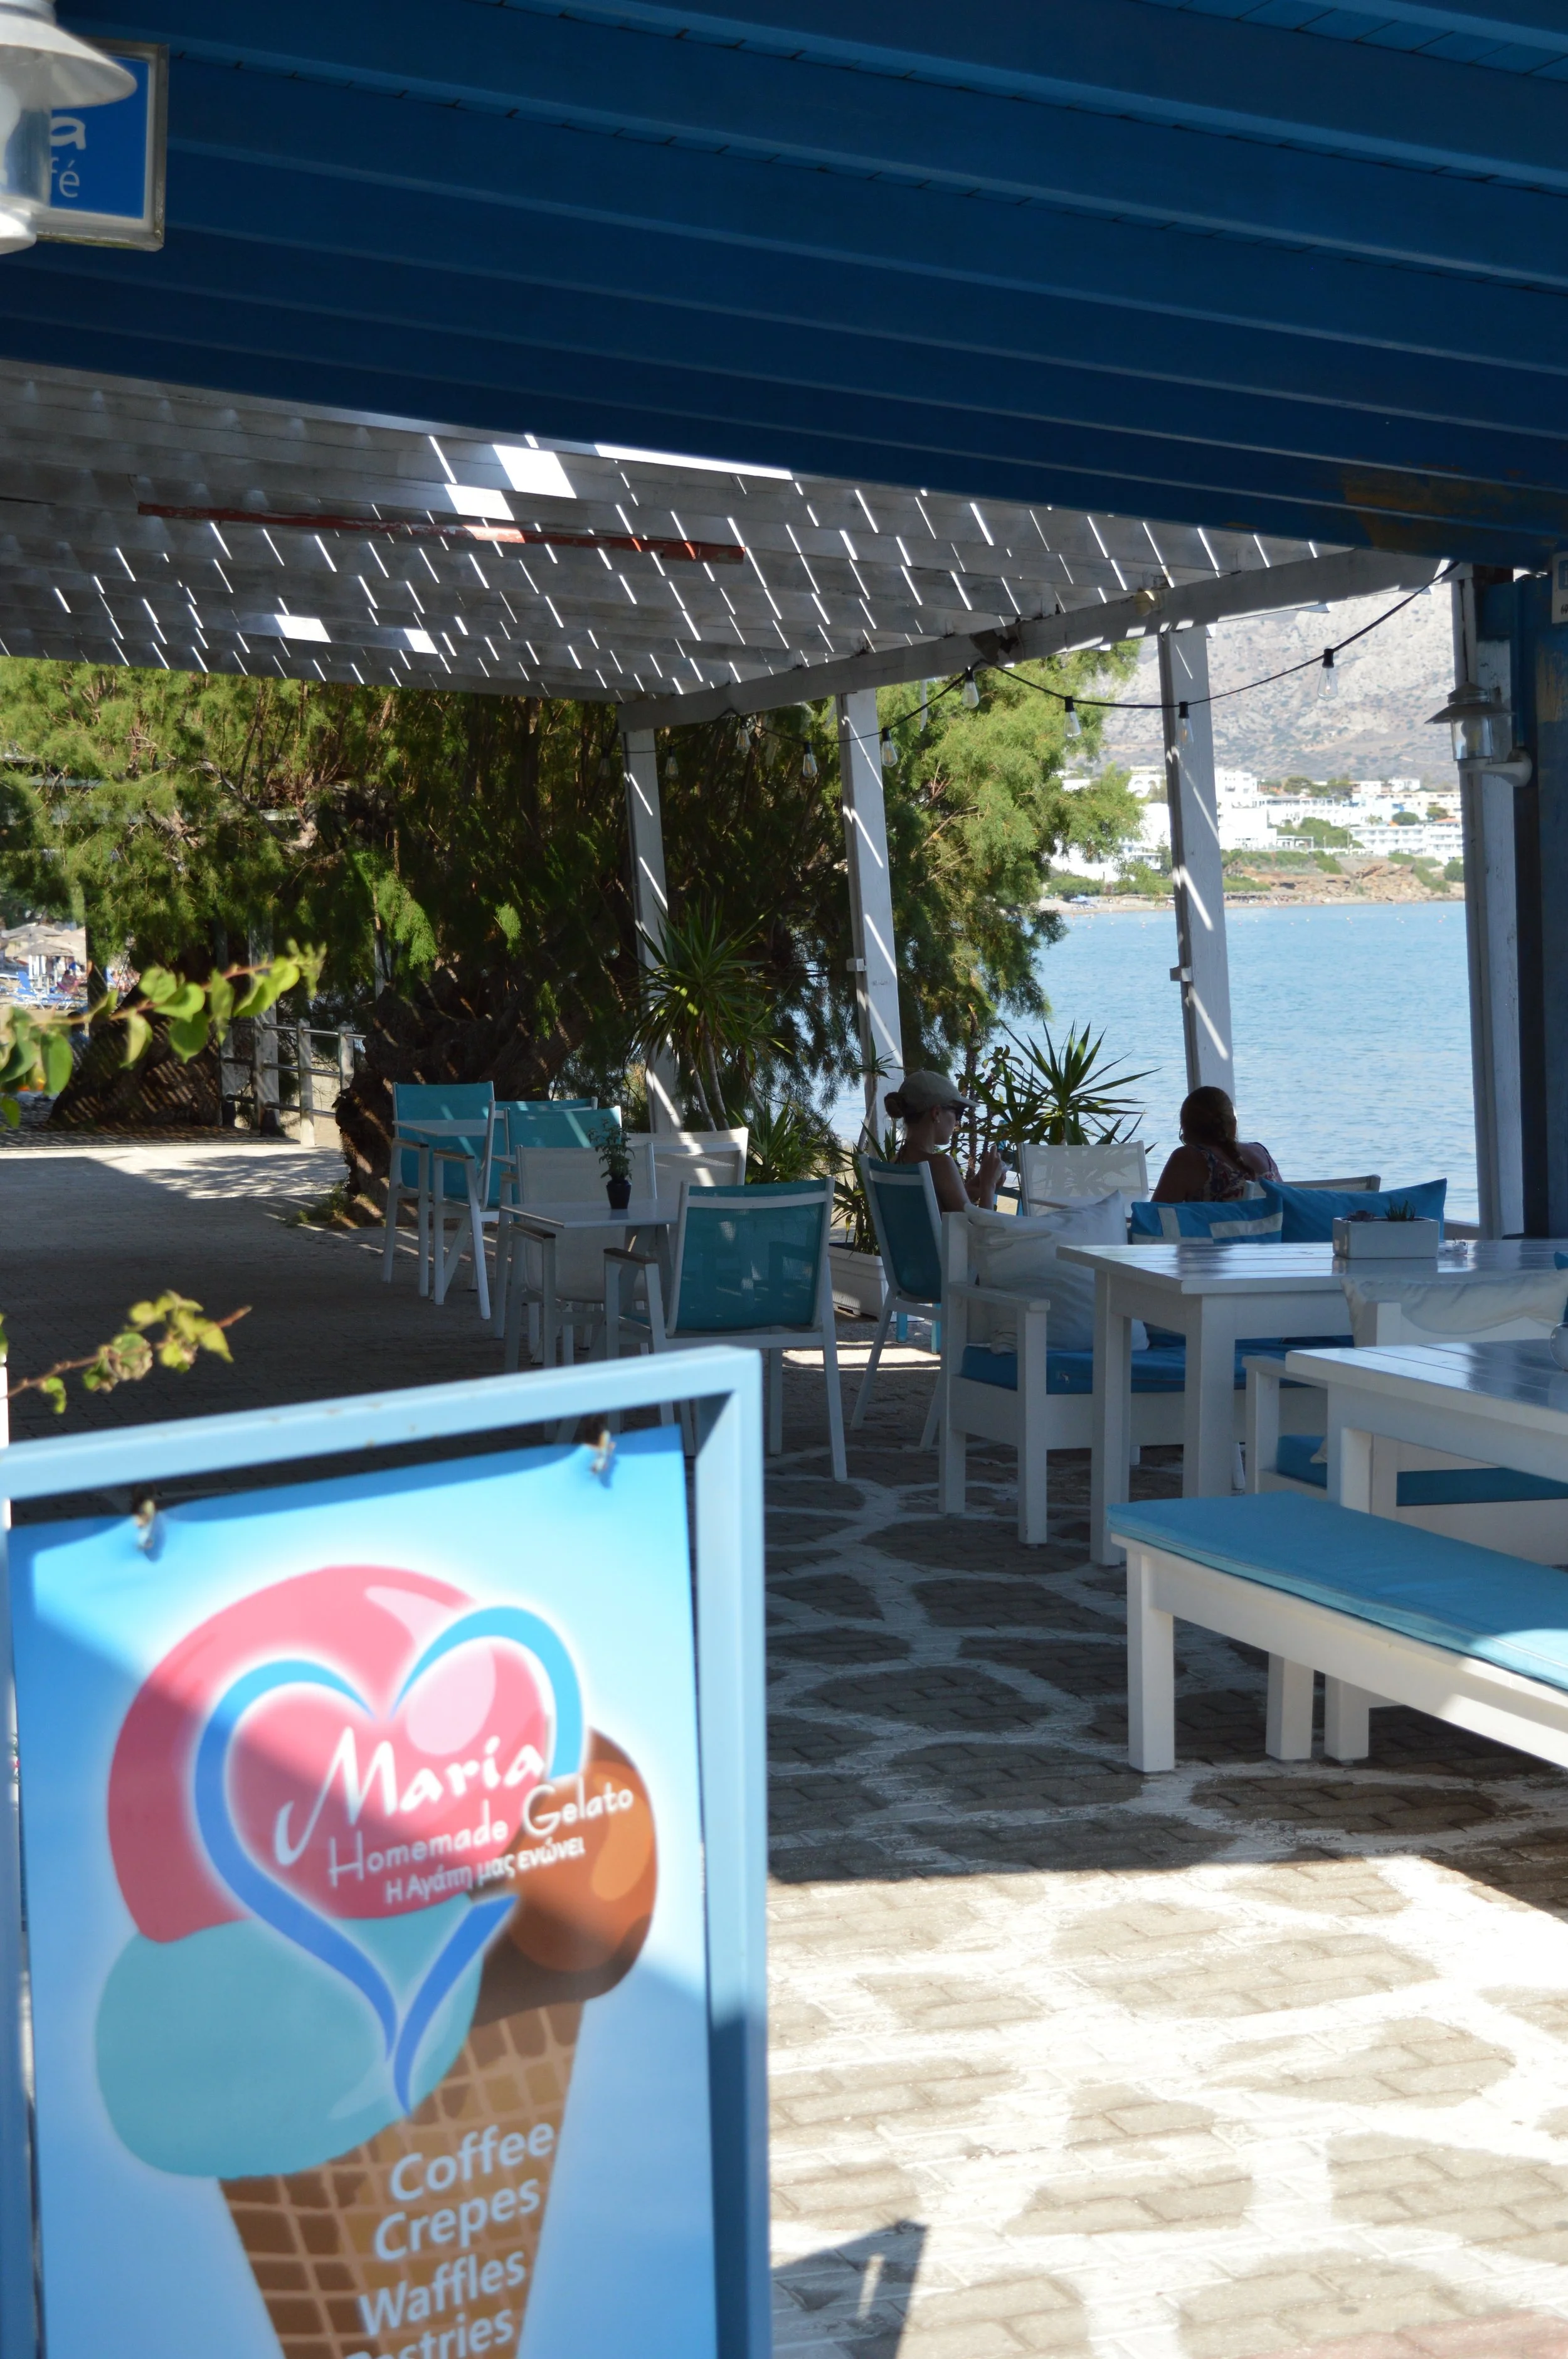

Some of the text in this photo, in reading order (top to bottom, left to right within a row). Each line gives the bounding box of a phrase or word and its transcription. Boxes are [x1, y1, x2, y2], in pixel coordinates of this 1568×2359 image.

[329, 1776, 633, 1887] Homemade Gelato
[390, 2122, 554, 2200] Coffee
[375, 2179, 540, 2260] Crepes
[346, 2309, 514, 2359] tries
[358, 2251, 525, 2336] Waffles
